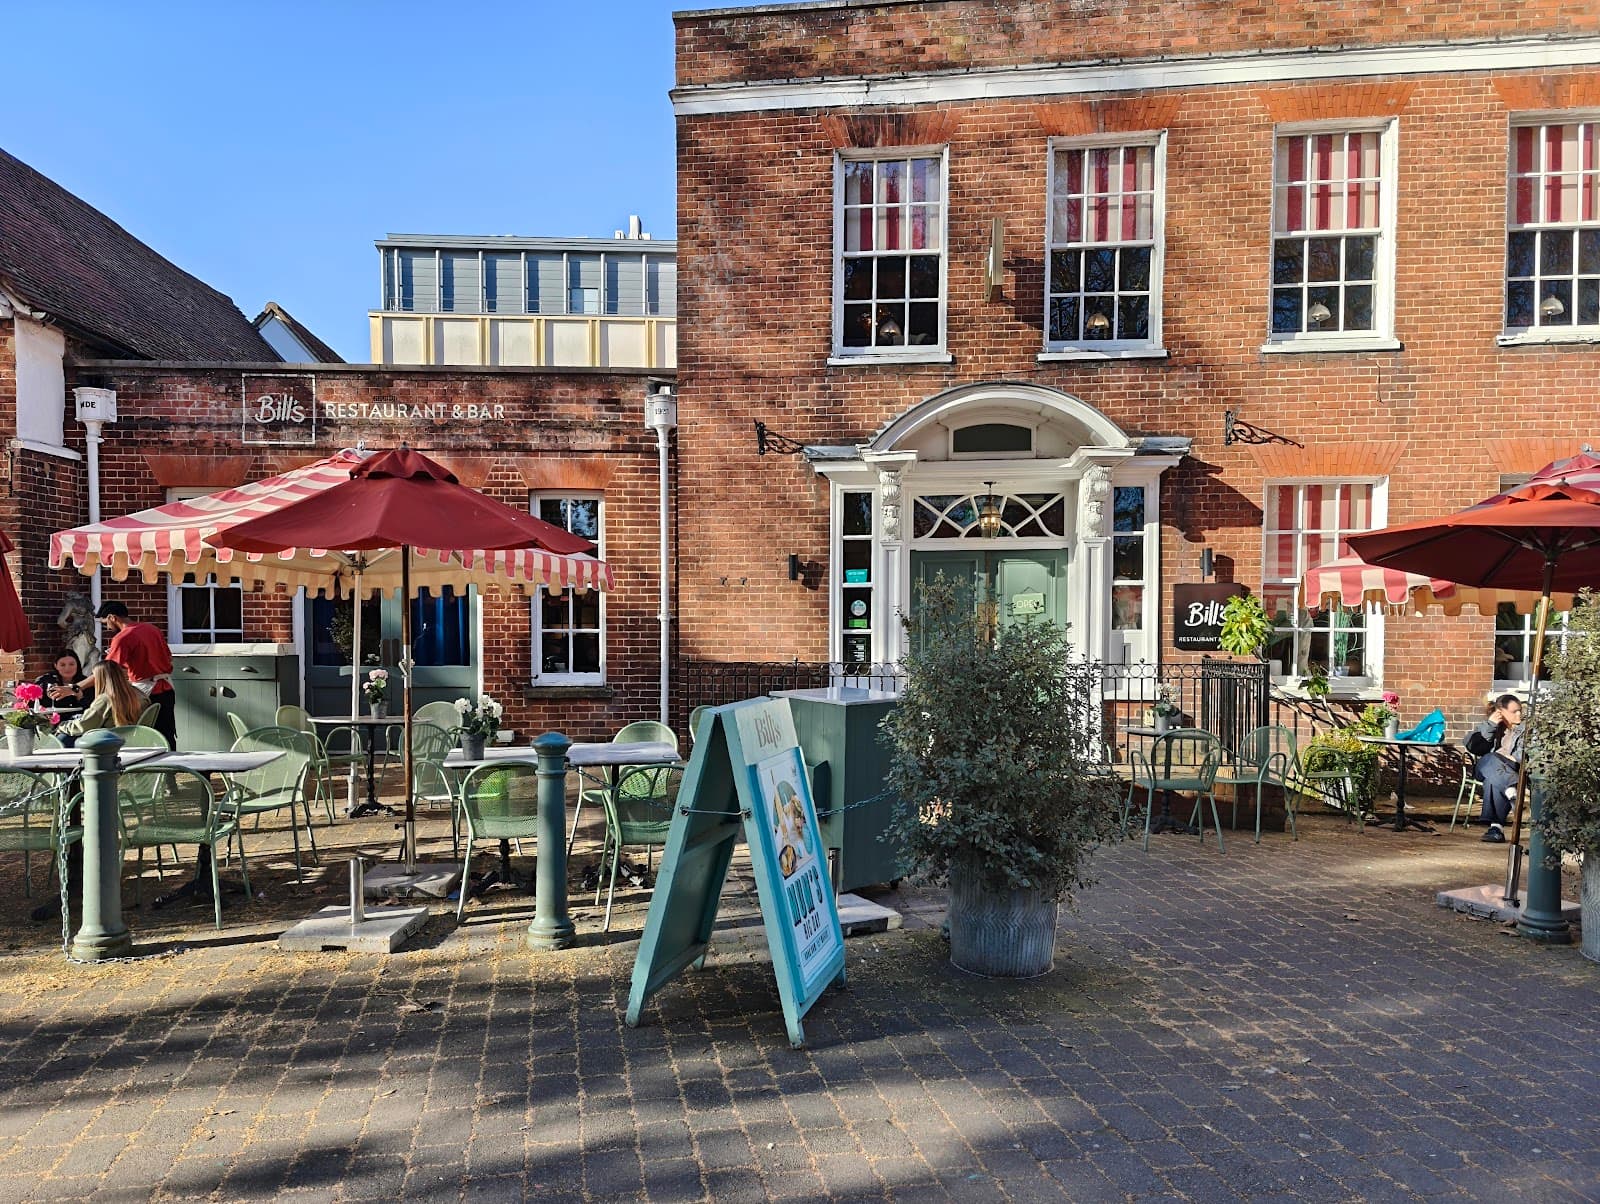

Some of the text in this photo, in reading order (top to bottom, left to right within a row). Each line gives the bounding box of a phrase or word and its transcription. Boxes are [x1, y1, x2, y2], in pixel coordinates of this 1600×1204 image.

[255, 395, 305, 423] Bill's
[325, 403, 505, 419] RESTAURANT & BAR
[786, 865, 823, 927] MUM'S
